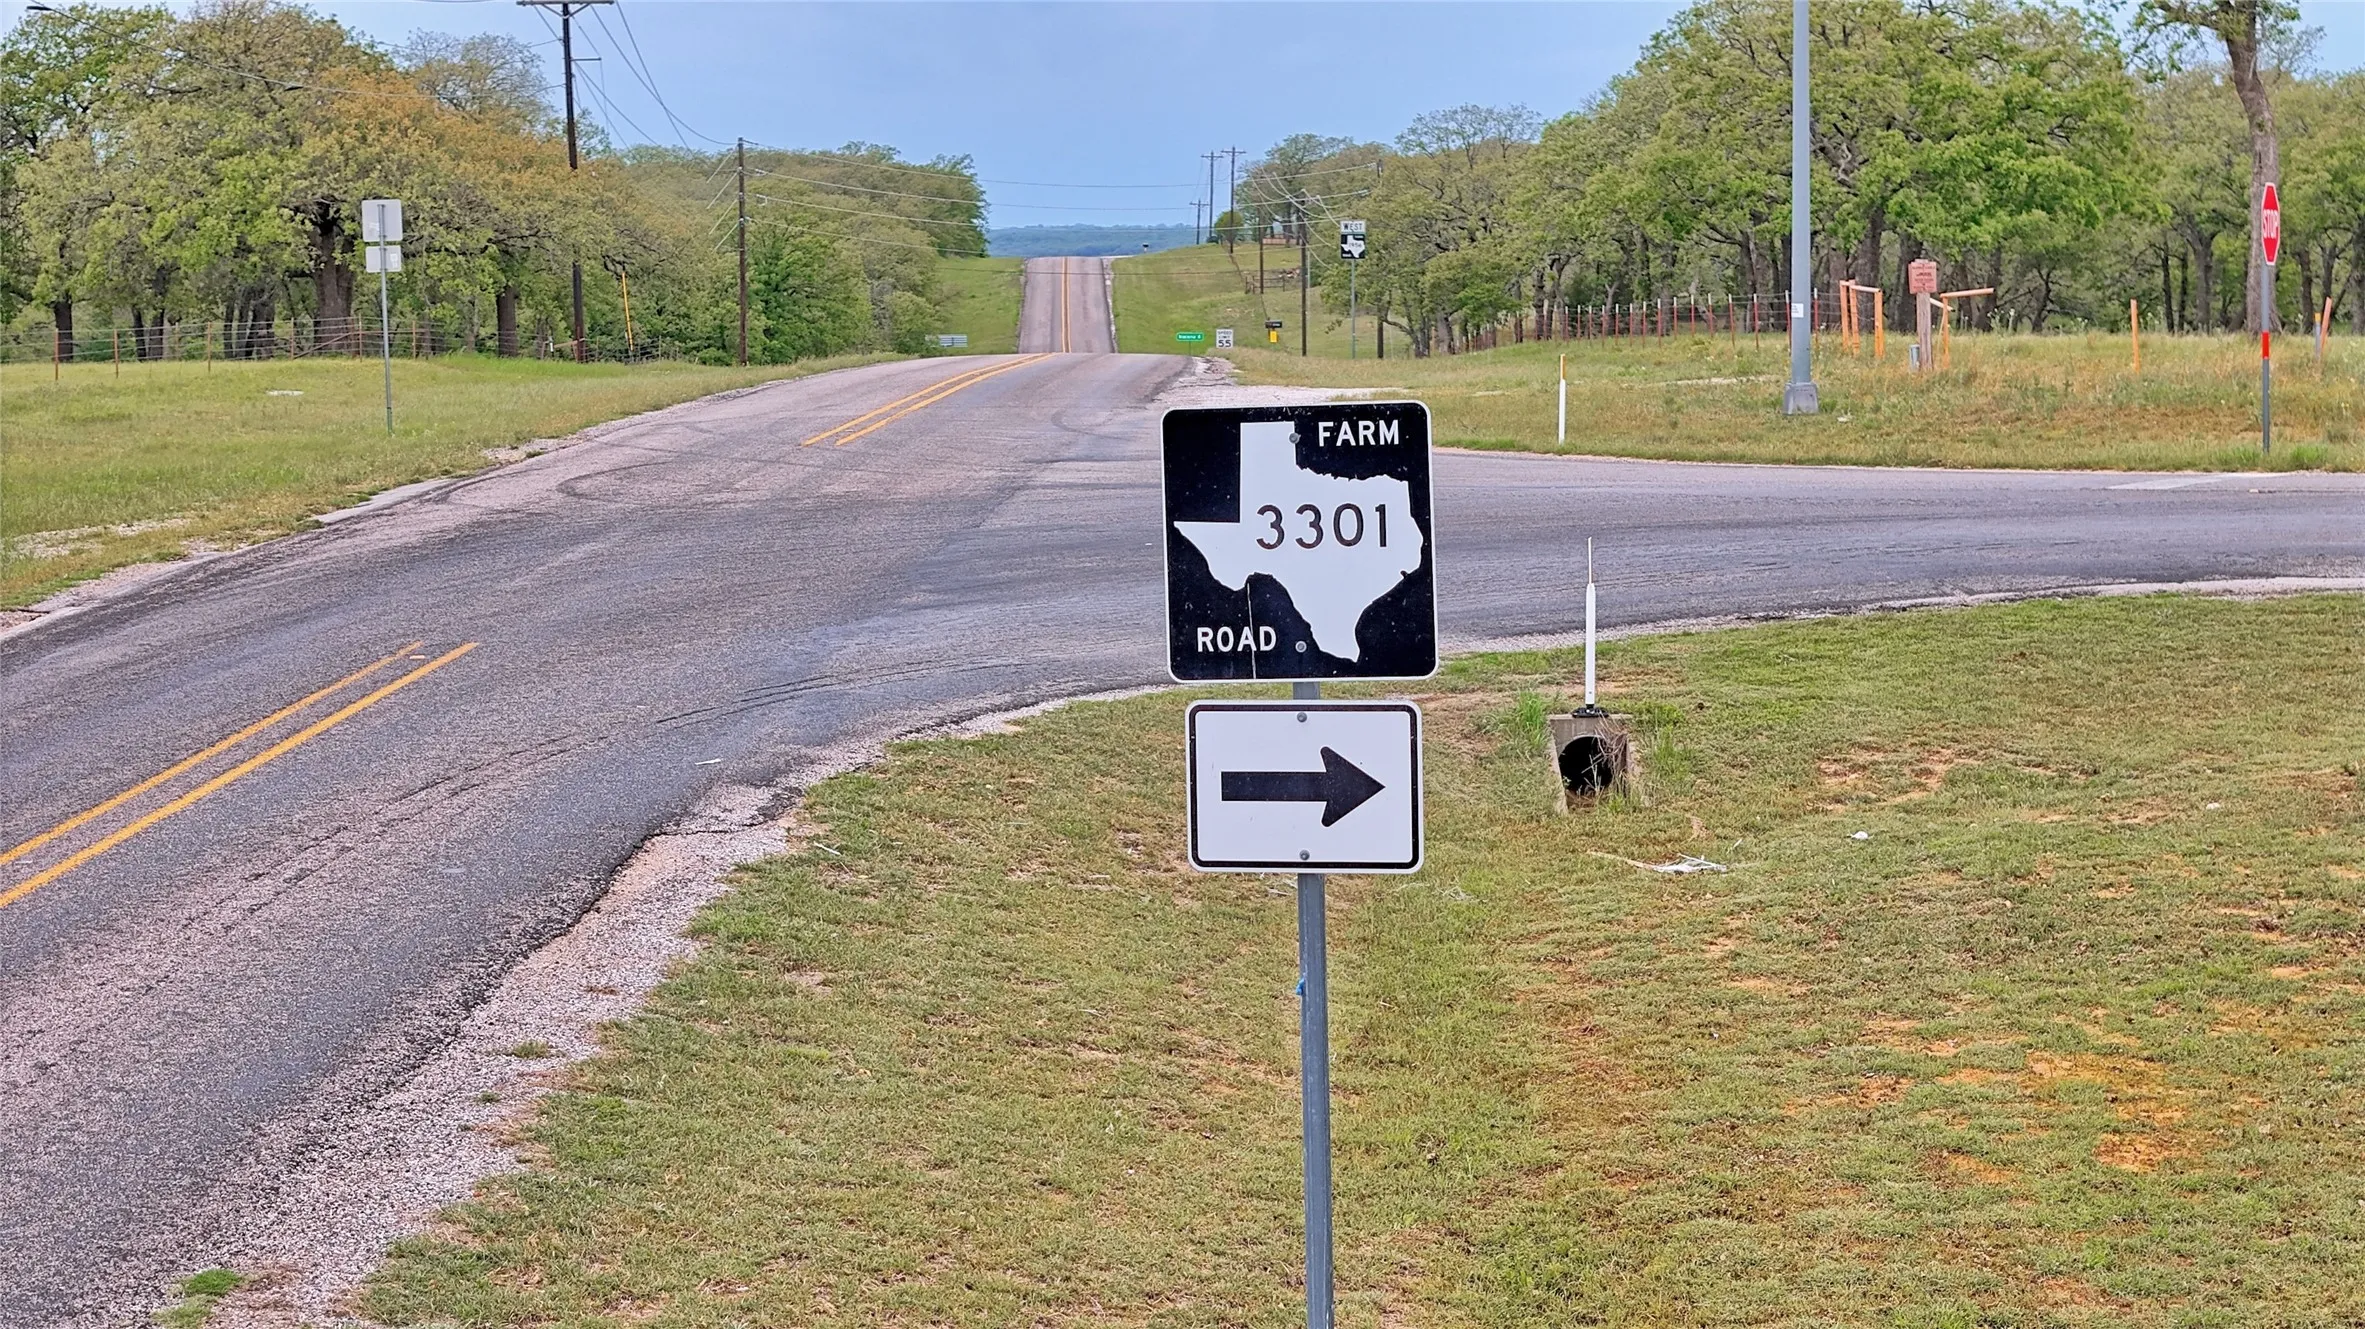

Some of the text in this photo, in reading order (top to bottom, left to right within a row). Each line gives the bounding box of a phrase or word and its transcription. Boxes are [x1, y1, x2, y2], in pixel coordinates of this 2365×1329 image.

[1343, 223, 1363, 231] WEST
[2263, 209, 2278, 239] STOP
[1218, 339, 1231, 347] 55
[1318, 420, 1400, 447] FARM
[1256, 503, 1388, 550] 3301
[1197, 626, 1277, 653] ROAD
